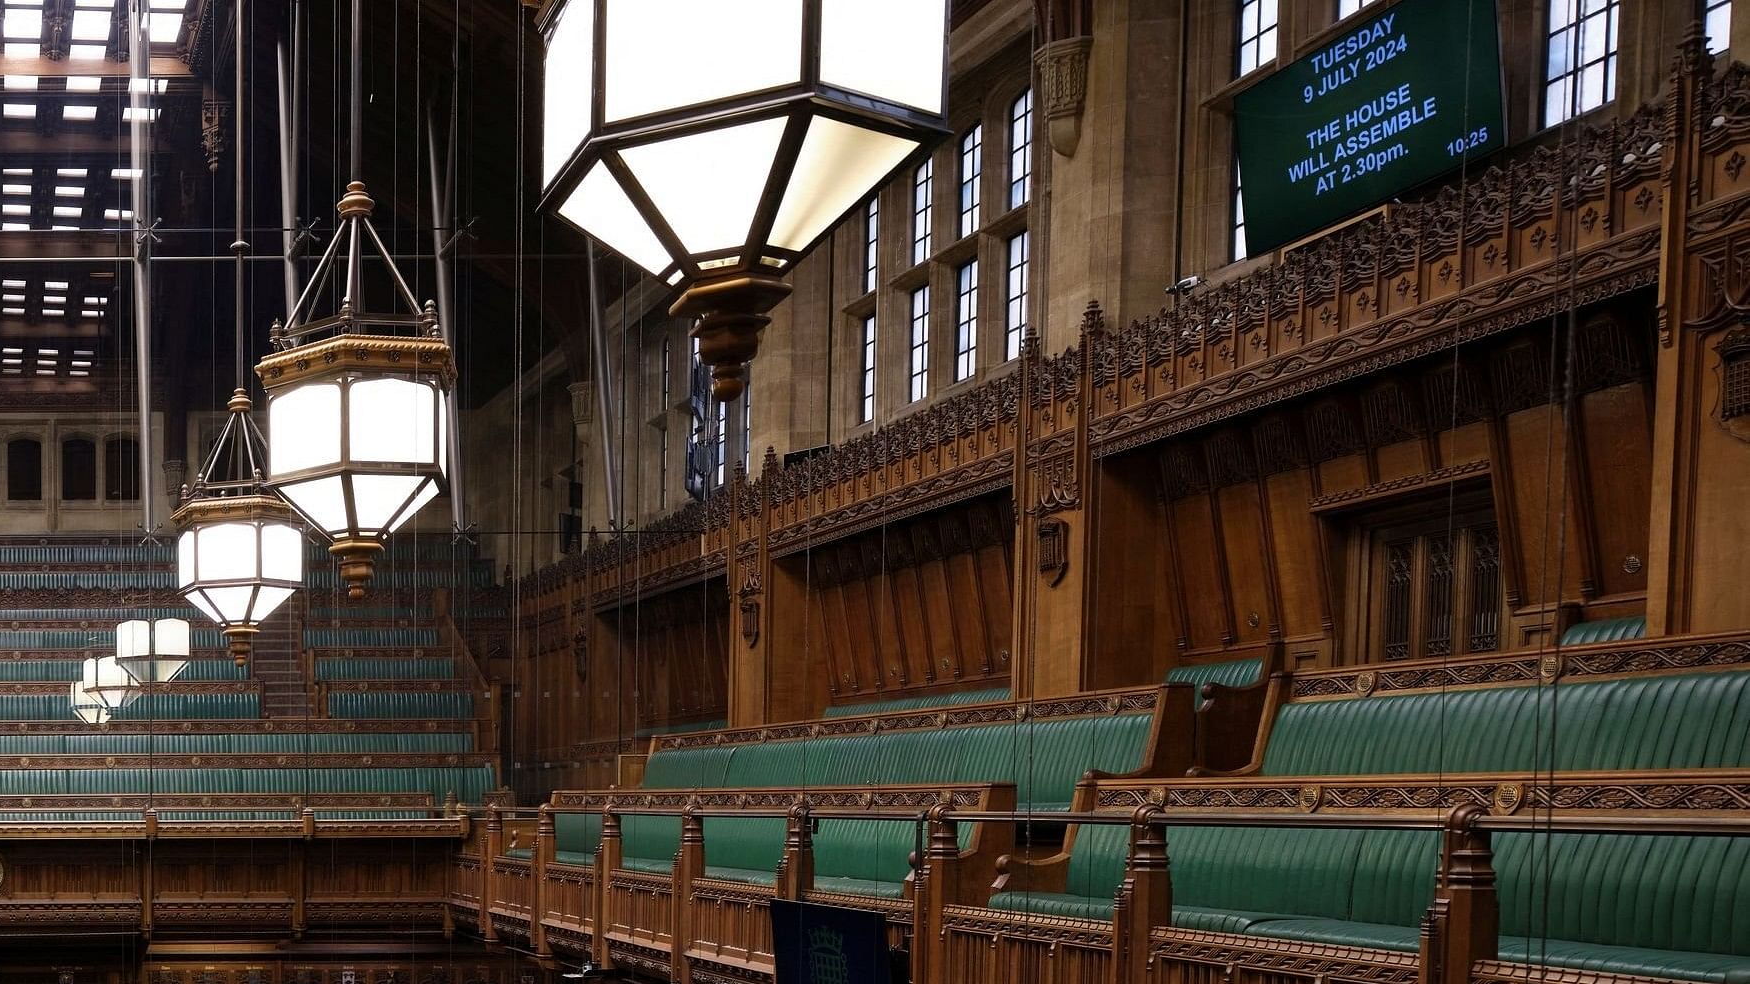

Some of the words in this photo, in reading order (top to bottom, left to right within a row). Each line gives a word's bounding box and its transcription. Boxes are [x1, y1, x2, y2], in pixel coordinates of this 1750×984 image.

[1303, 85, 1313, 104] 9
[1318, 61, 1362, 96] JULY
[1366, 34, 1408, 72] 2024
[1311, 13, 1395, 74] TUESDAY
[1288, 154, 1329, 183] WILL
[1334, 97, 1437, 162] ASSEMBLE
[1306, 119, 1340, 150] THE
[1345, 83, 1411, 135] HOUSE
[1446, 127, 1489, 157] 10:25
[1316, 170, 1336, 195] AT
[1341, 143, 1409, 184] 2.30pm.
